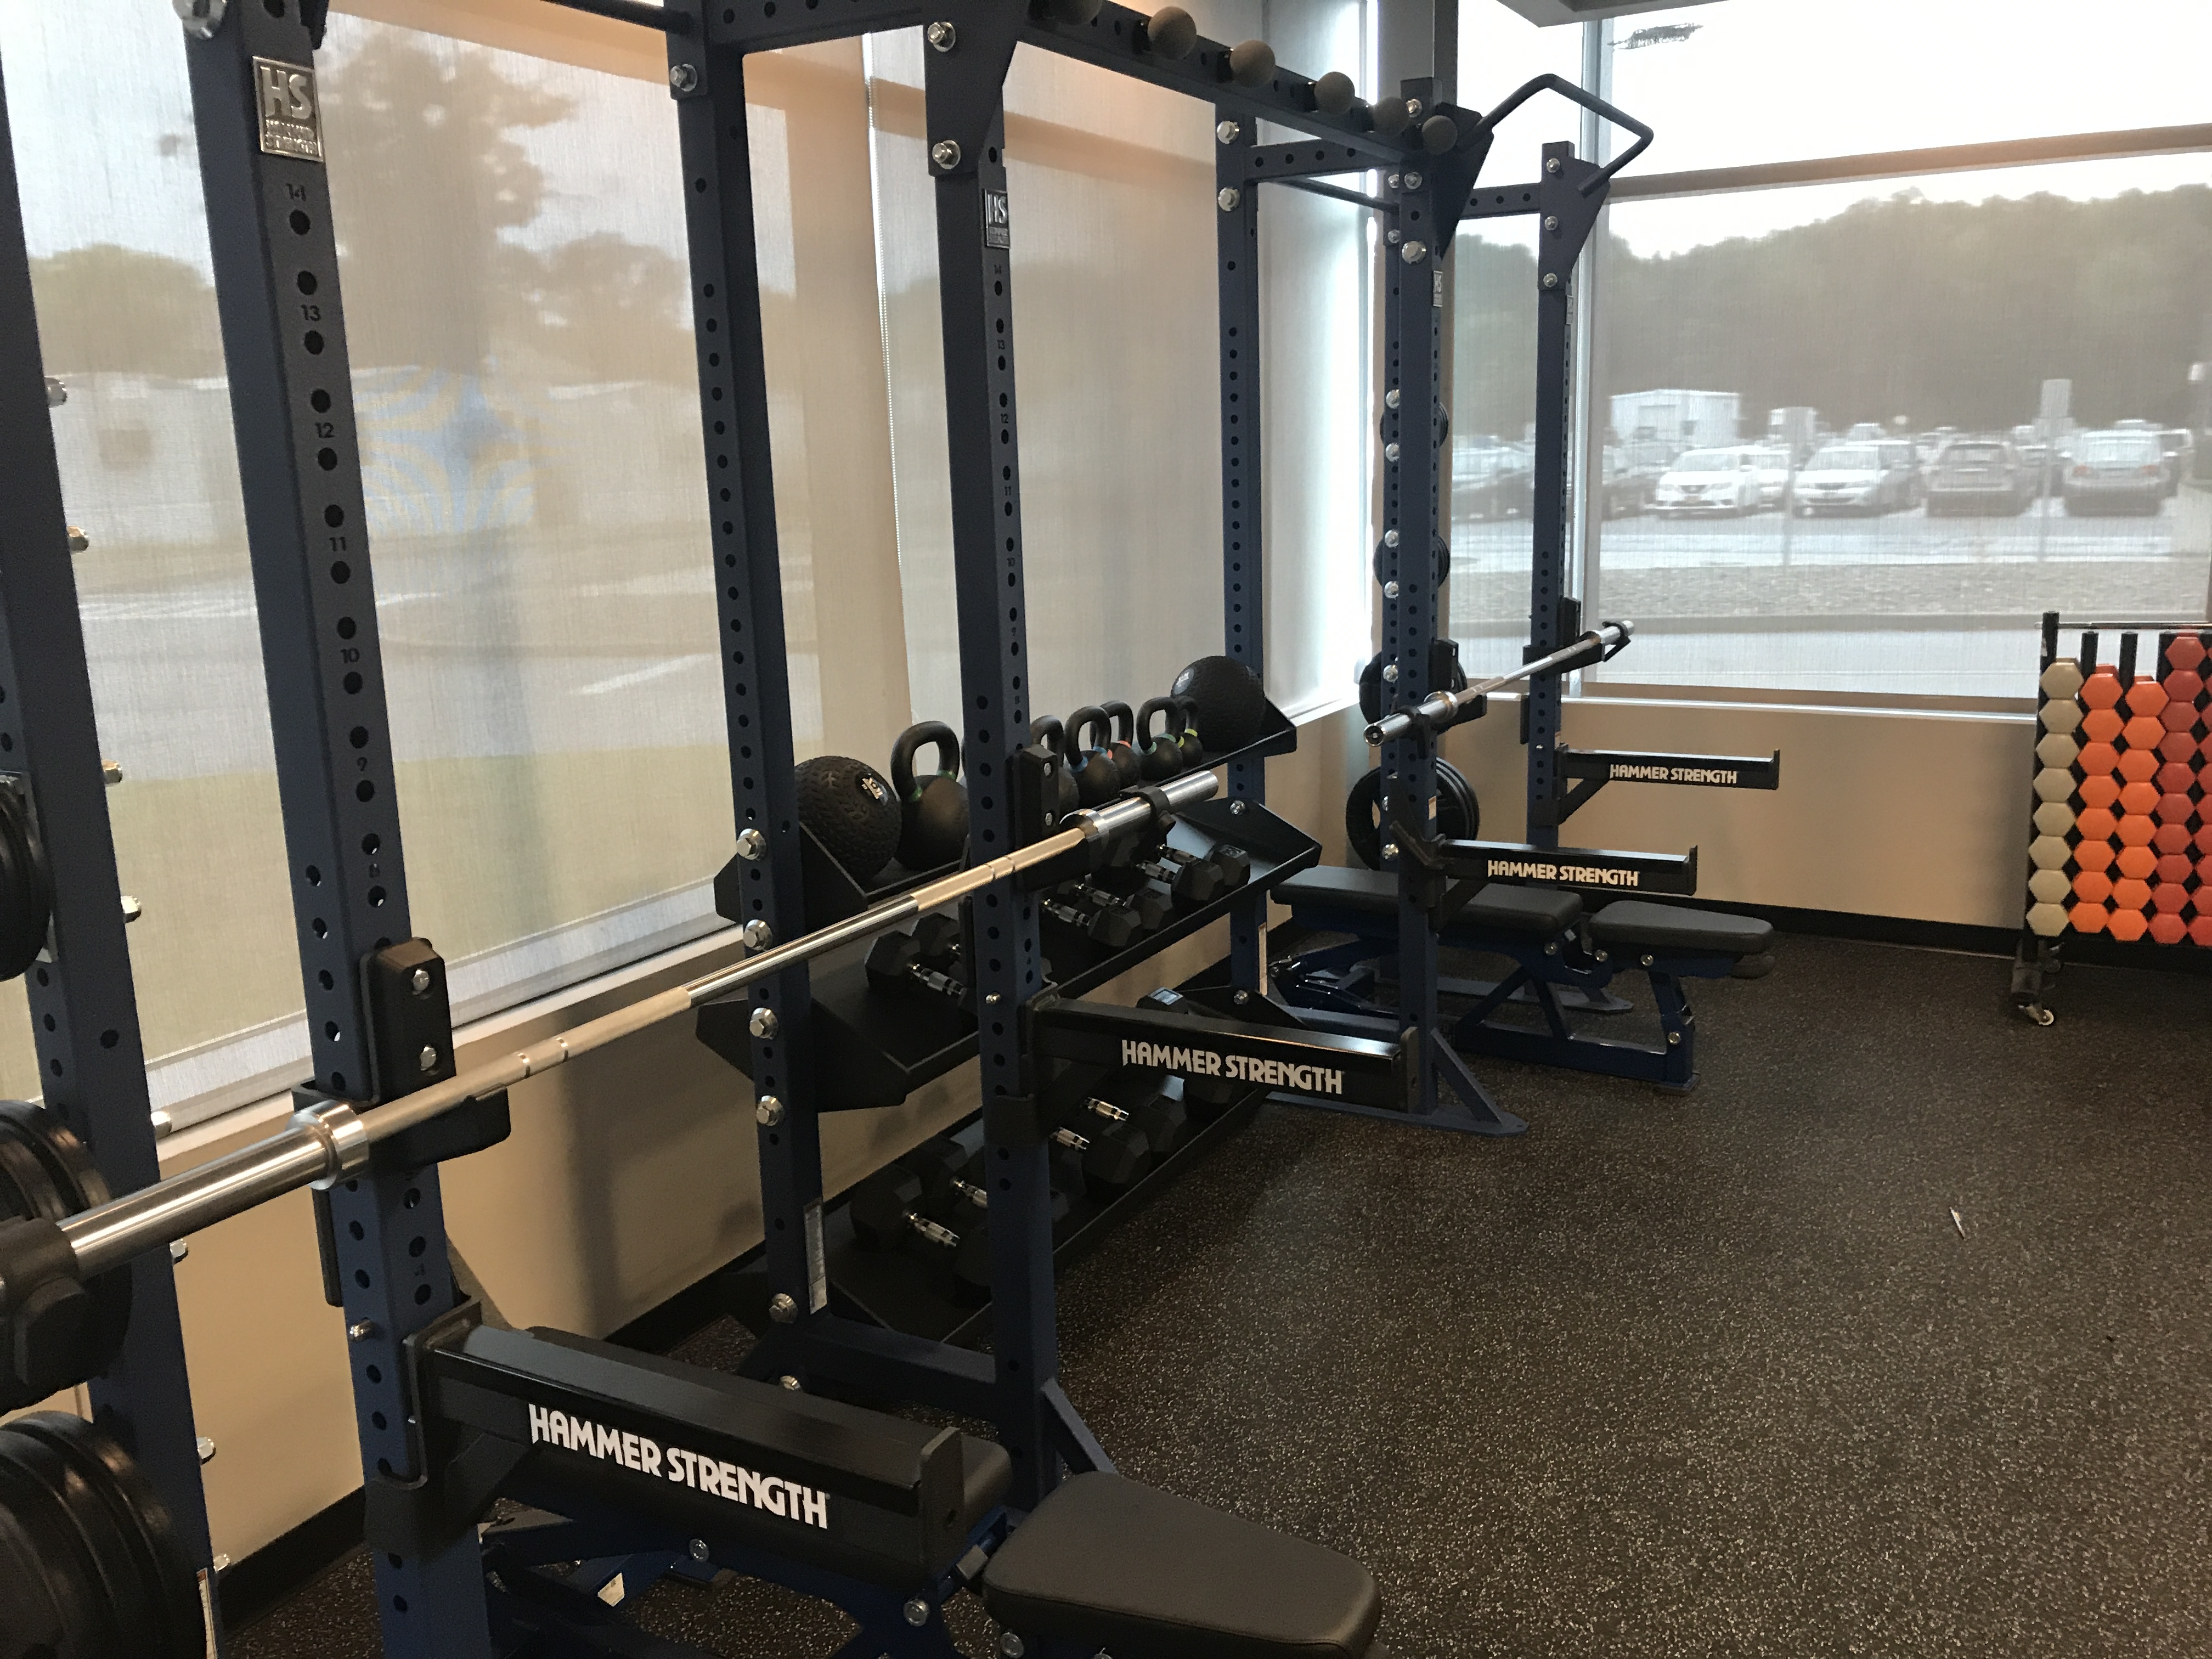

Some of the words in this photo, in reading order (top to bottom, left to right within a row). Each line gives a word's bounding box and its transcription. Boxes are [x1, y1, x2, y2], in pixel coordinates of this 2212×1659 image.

[260, 66, 312, 119] HS
[286, 183, 306, 201] 14
[988, 194, 1007, 224] HS
[301, 304, 321, 321] 13
[997, 340, 1005, 349] 13
[1000, 413, 1008, 424] 12
[315, 422, 335, 438] 12
[1004, 486, 1012, 496] 11
[329, 537, 347, 552] 11
[1007, 557, 1015, 567] 10
[340, 647, 360, 664] 10
[1610, 764, 1669, 780] HAMMER
[1671, 768, 1737, 784] STRENGTH
[1487, 860, 1556, 880] HAMMER
[1559, 865, 1638, 887] STRENGTH
[1122, 1040, 1222, 1076] HAMMER
[1225, 1054, 1342, 1094] STRENGTH
[528, 1403, 662, 1477] HAMMER
[667, 1447, 827, 1529] STRENGTH
